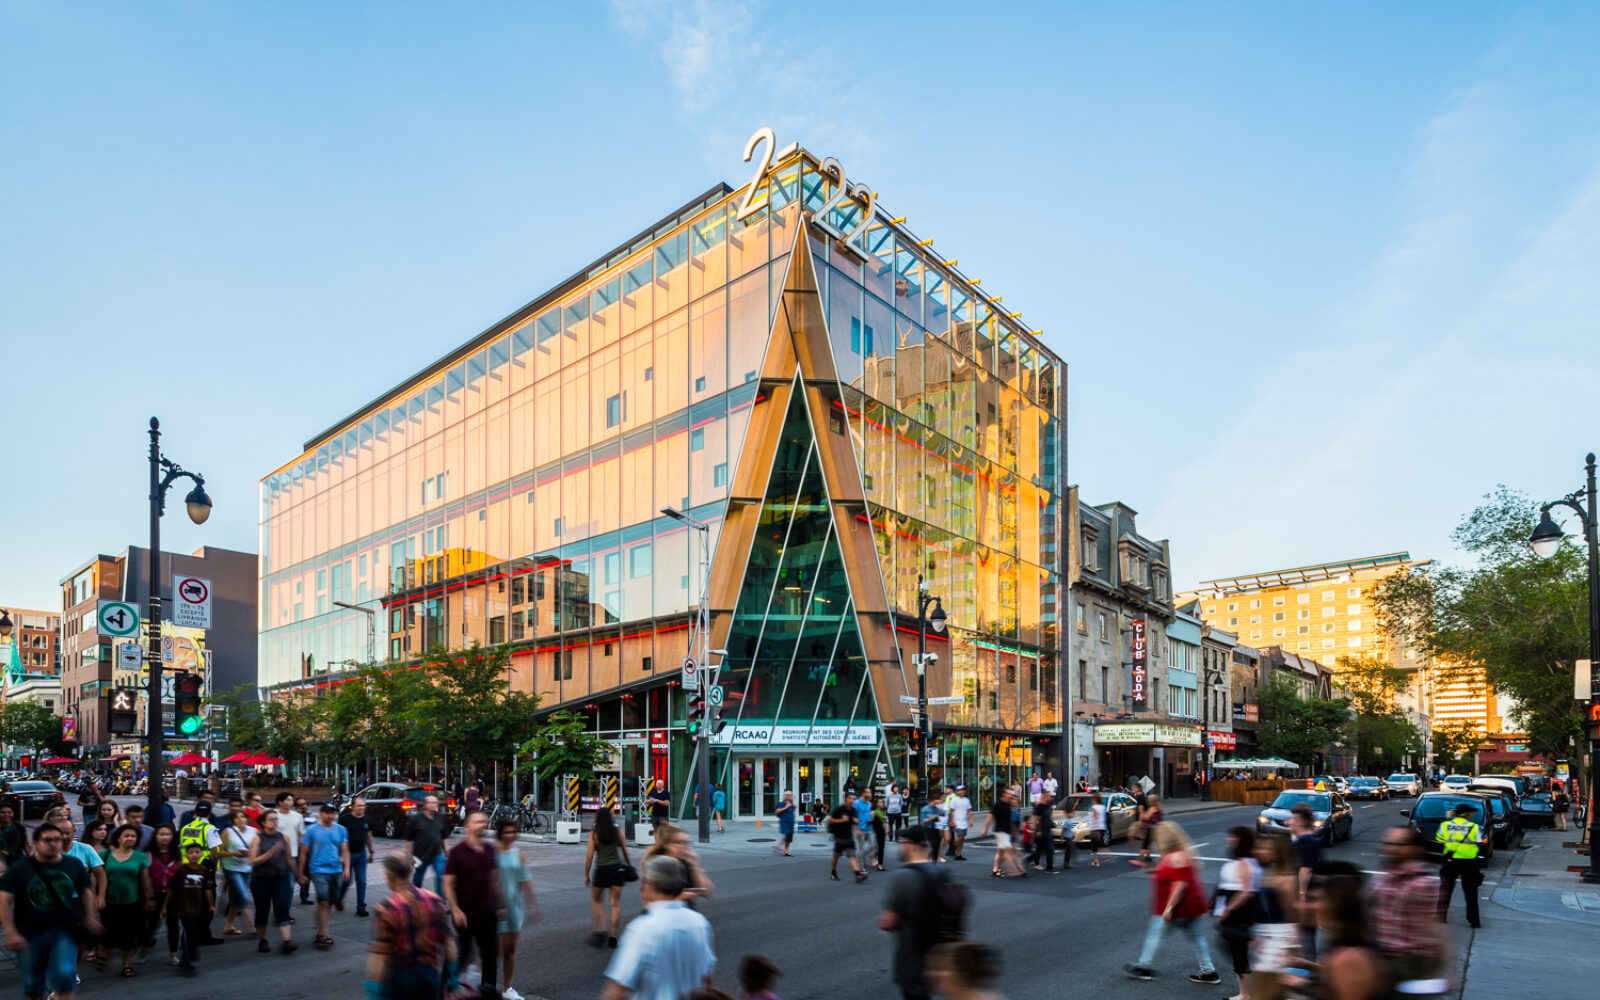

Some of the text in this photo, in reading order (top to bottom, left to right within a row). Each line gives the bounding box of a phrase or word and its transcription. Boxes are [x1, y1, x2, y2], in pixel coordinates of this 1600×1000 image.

[1135, 624, 1143, 701] CLUB SODA
[735, 730, 768, 740] RCAAQ
